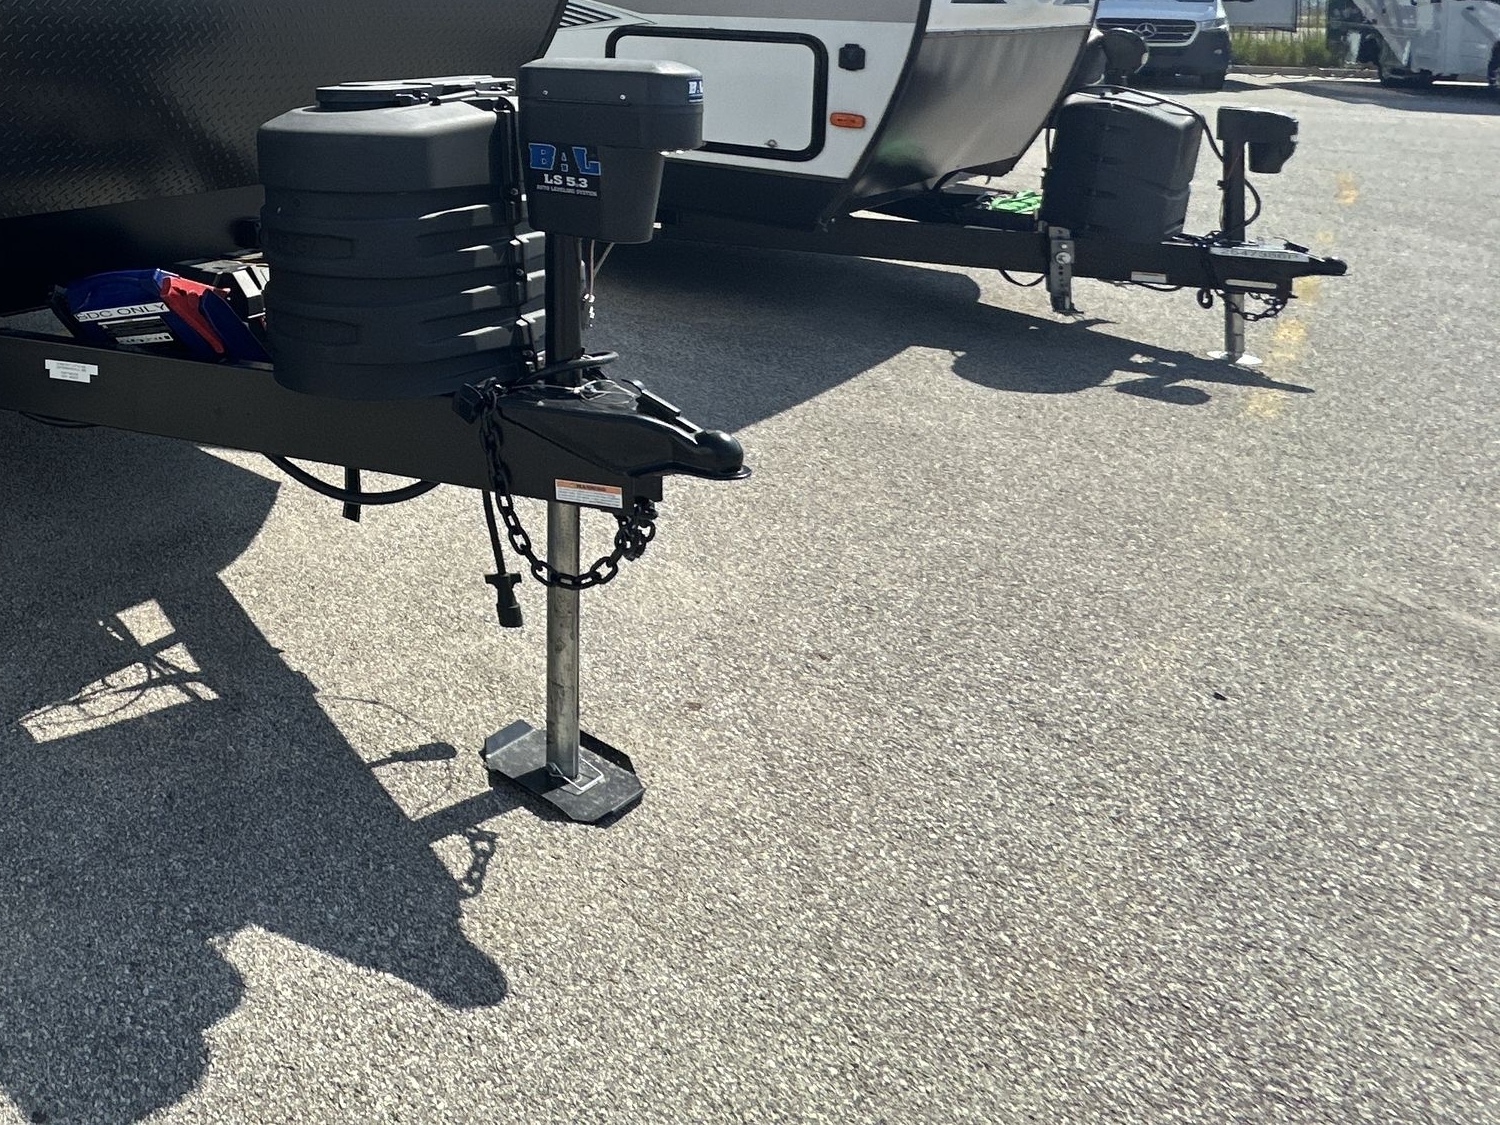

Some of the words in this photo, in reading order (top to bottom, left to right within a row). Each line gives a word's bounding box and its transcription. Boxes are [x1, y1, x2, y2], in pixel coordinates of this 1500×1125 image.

[543, 173, 563, 186] LS
[566, 176, 588, 189] 5.3
[116, 303, 165, 315] ONLY
